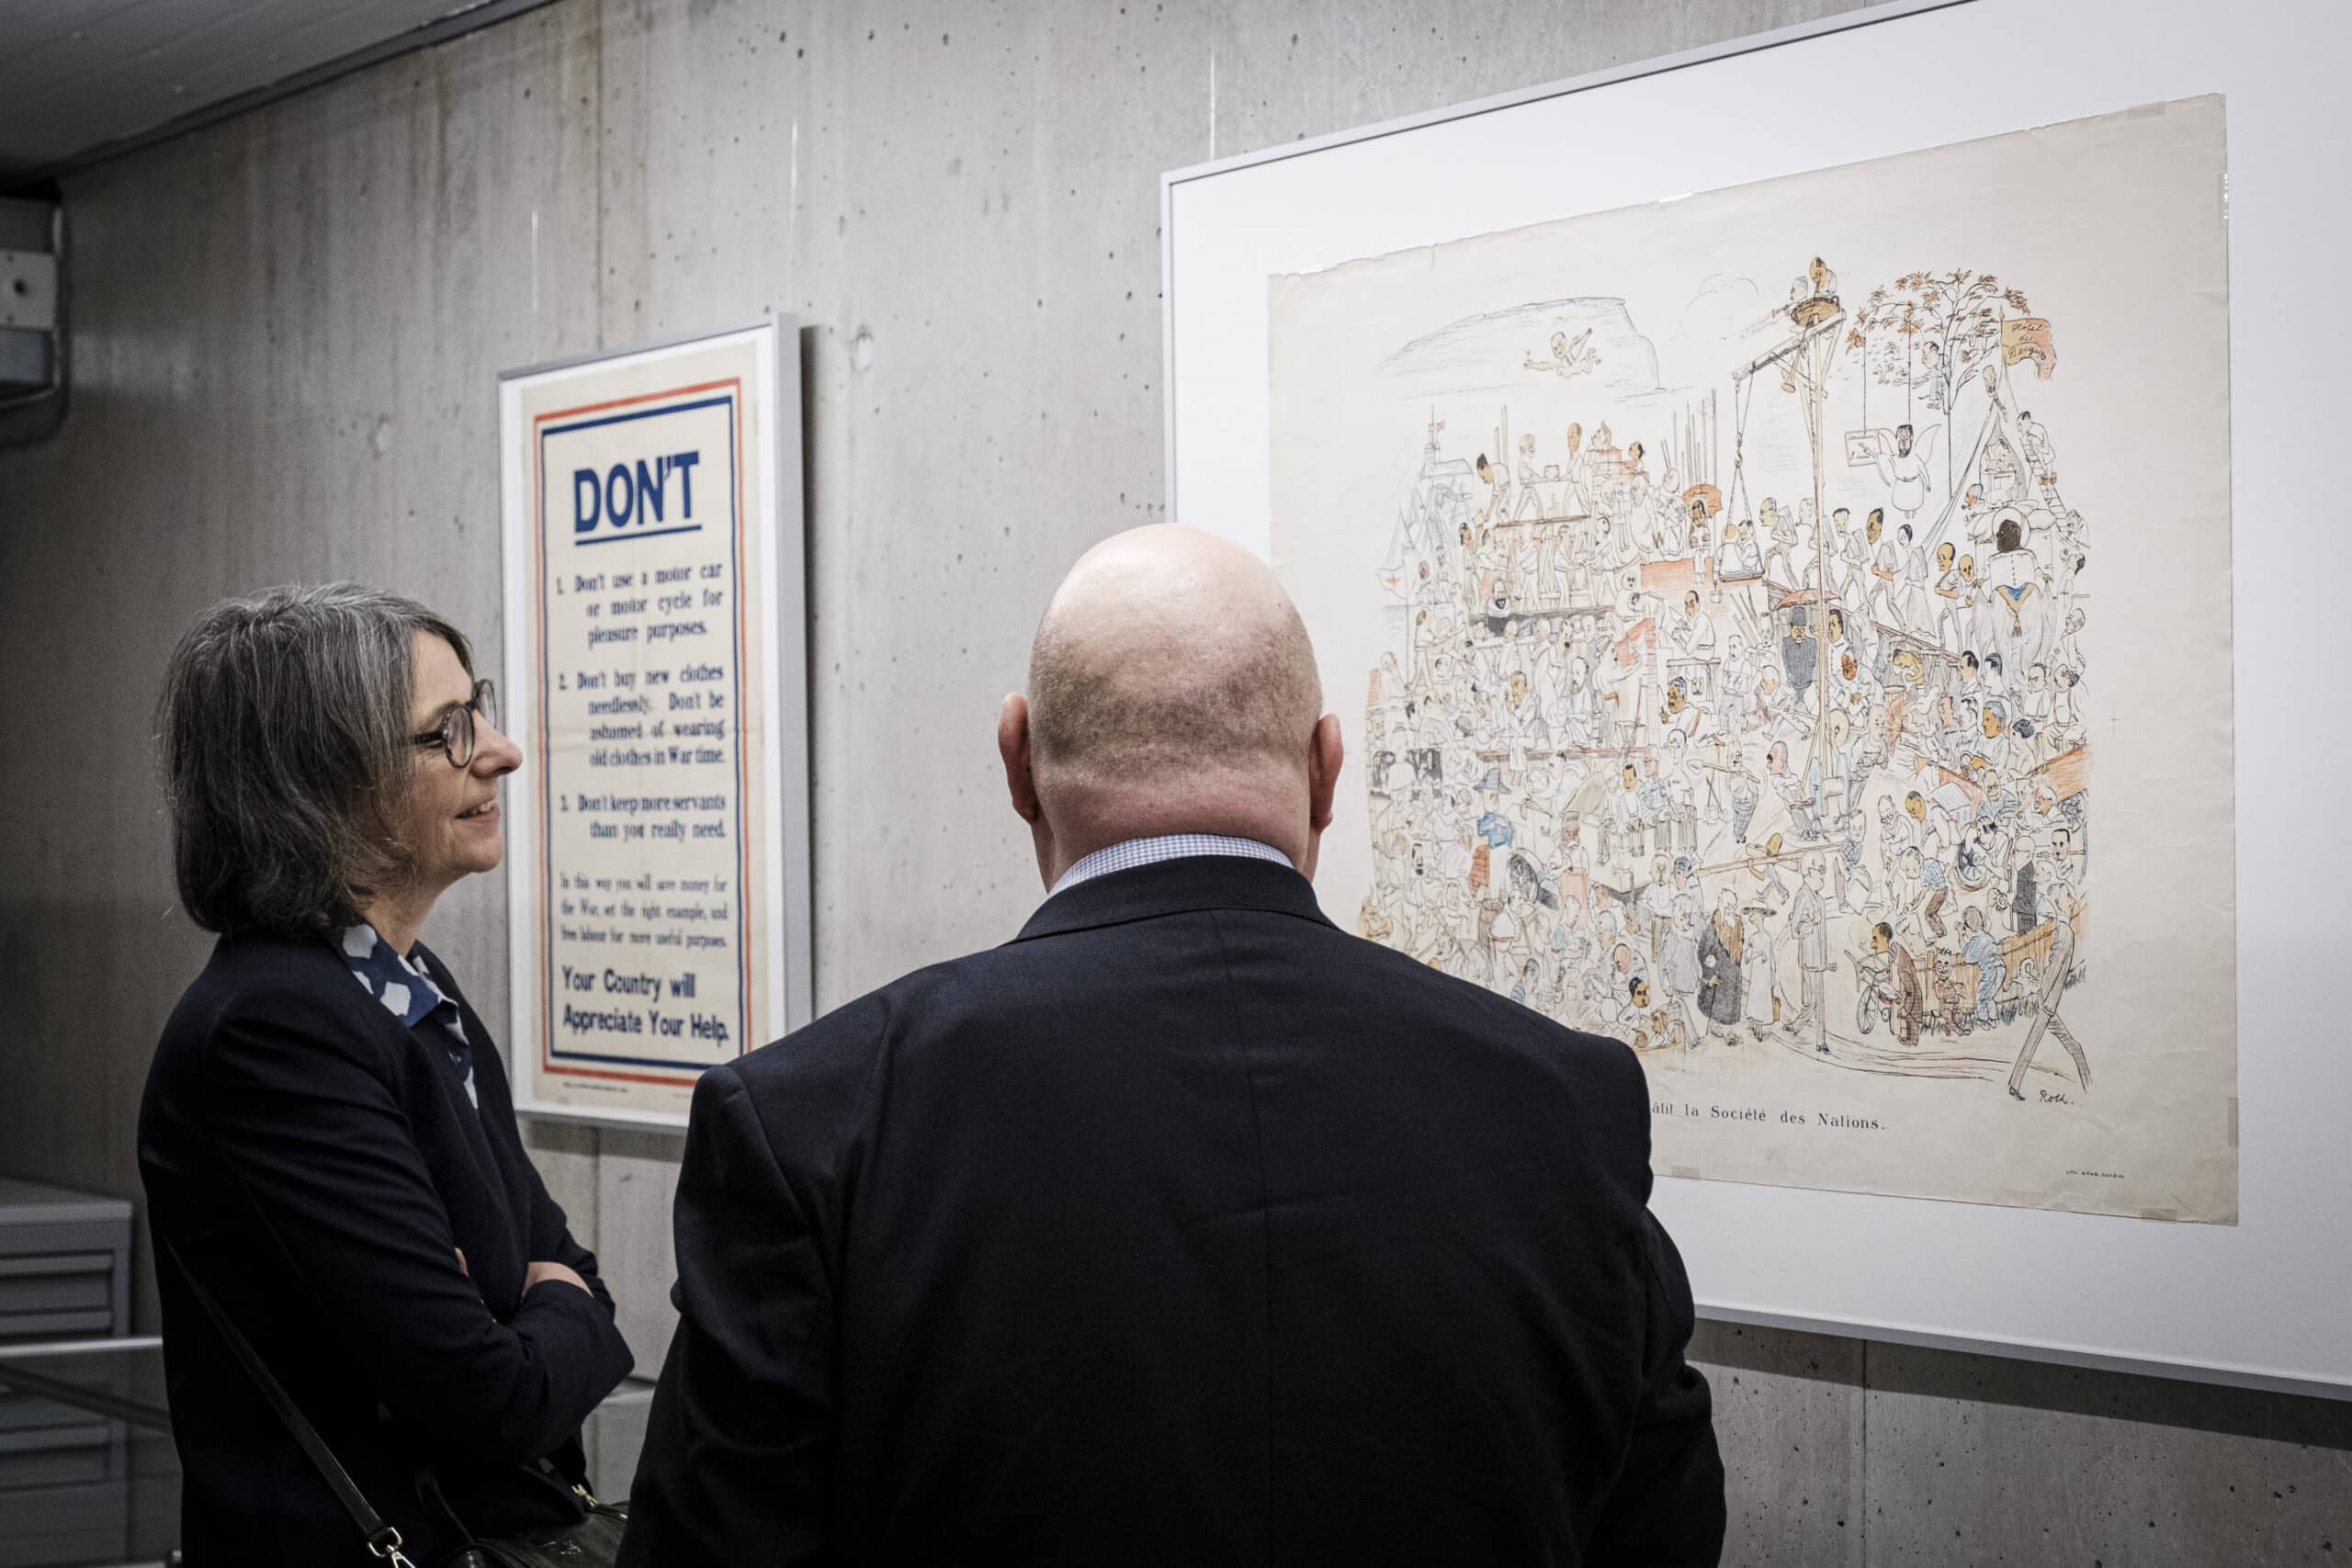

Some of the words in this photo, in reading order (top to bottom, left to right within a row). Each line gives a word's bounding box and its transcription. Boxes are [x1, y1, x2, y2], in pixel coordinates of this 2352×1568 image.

[573, 450, 700, 534] DON'T
[574, 573, 605, 592] Don't
[613, 575, 633, 588] use
[655, 566, 692, 584] motor
[700, 563, 723, 579] car
[586, 603, 600, 617] or
[610, 598, 648, 616] motor
[658, 592, 692, 615] cycle
[703, 589, 723, 607] for
[588, 626, 638, 650] pleasure
[647, 620, 707, 644] purposes.
[577, 671, 606, 689] Don't
[615, 670, 636, 690] buy
[646, 670, 670, 684] new
[680, 663, 724, 682] clothes
[669, 692, 701, 711] Don't
[709, 691, 724, 708] be
[589, 722, 642, 741] ashamed
[650, 720, 664, 739] of
[673, 718, 726, 740] wearing
[589, 750, 606, 767] old
[609, 748, 651, 766] clothes
[654, 747, 665, 765] in
[668, 746, 693, 765] War
[578, 794, 607, 812] Don't
[610, 794, 639, 817] keep
[642, 795, 672, 811] more
[673, 795, 726, 810] servants
[590, 819, 617, 839] than
[623, 823, 644, 842] you
[650, 819, 685, 843] really
[573, 873, 589, 888] this
[595, 876, 611, 891] way
[616, 878, 632, 893] you
[636, 874, 650, 890] will
[680, 879, 709, 894] money
[713, 874, 727, 892] for
[621, 899, 635, 916] the
[581, 926, 605, 942] labour
[610, 926, 624, 943] for
[629, 931, 651, 944] more
[655, 929, 683, 946] useful
[561, 965, 595, 992] Your
[604, 967, 662, 1003] Country
[669, 973, 696, 998] will
[563, 1003, 642, 1036] Appreciate
[648, 1010, 684, 1037] Your
[690, 1013, 729, 1048] Help.
[1651, 1101, 1674, 1115] âtit
[1685, 1103, 1699, 1117] la
[1711, 1104, 1767, 1122] Société
[1780, 1110, 1806, 1125] des
[1817, 1111, 1886, 1131] Nations.
